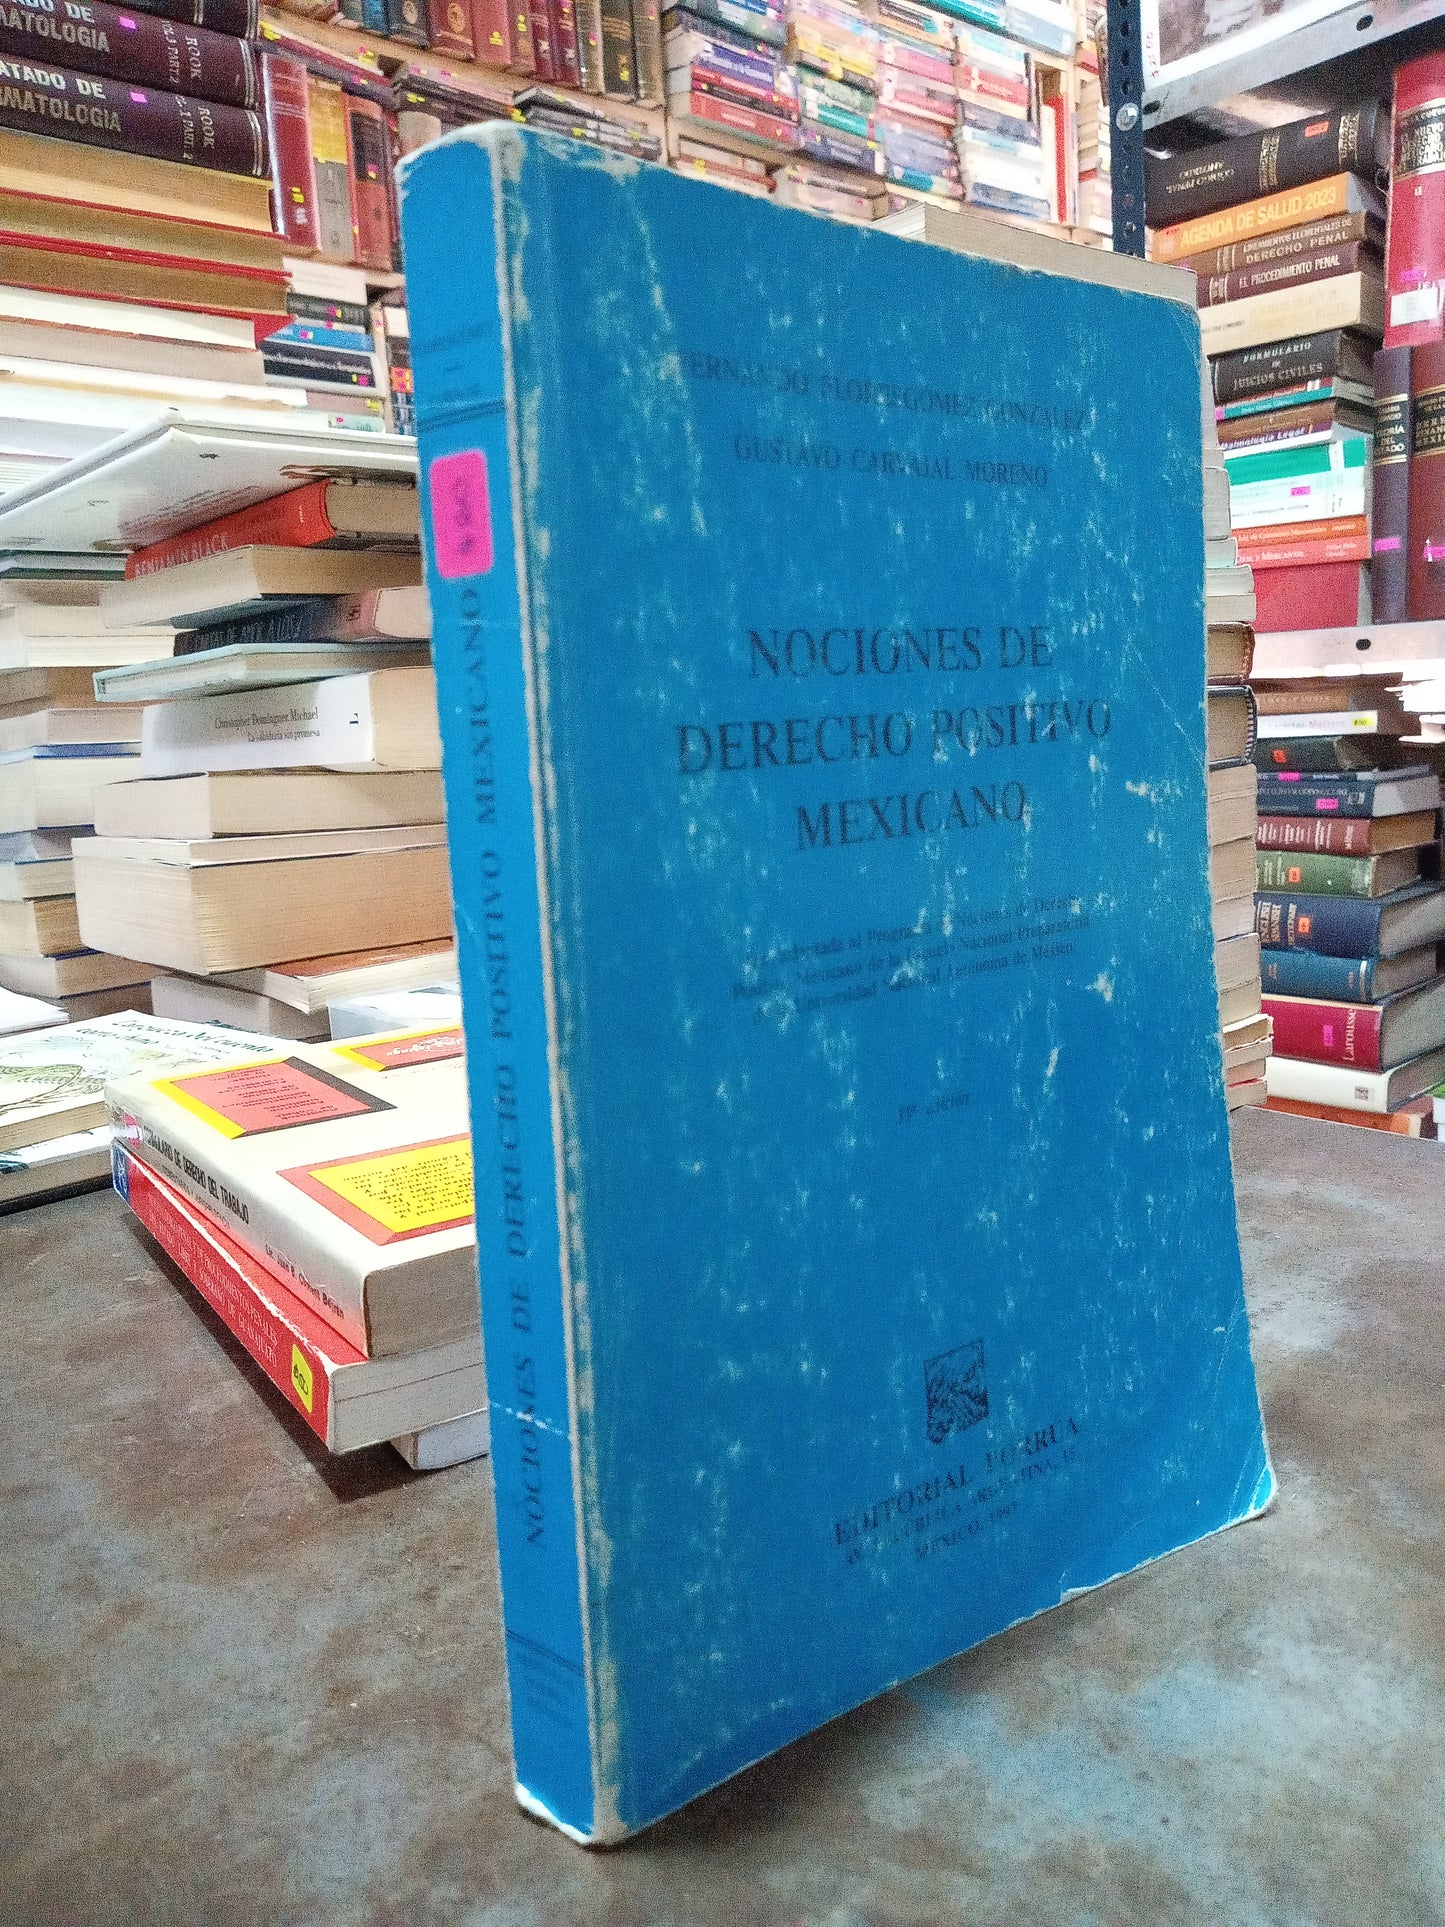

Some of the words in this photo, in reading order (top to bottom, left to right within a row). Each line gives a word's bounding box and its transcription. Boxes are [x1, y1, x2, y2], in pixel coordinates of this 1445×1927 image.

[64, 2, 95, 23] DE
[185, 35, 202, 80] ROOK
[75, 78, 107, 99] DE
[197, 106, 215, 150] ROOK
[1179, 217, 1234, 248] AGENDA
[1235, 210, 1256, 232] DE
[1257, 195, 1303, 225] SALUD
[1304, 186, 1338, 213] 2023
[1238, 277, 1250, 289] EL
[1250, 260, 1313, 286] PROCEDIMIENTO
[1314, 254, 1341, 271] PENAL
[1245, 241, 1303, 264] DERECHO
[1309, 230, 1350, 249] PENAL
[1232, 372, 1276, 391] JUICIOS
[1277, 362, 1323, 381] CIVILES
[1242, 341, 1312, 364] FORMULARIO
[733, 432, 842, 472] GUSTAVO
[850, 447, 956, 482] CARVAJAL
[965, 458, 1049, 487] MORENO
[191, 532, 229, 562] BLACK
[746, 626, 984, 680] NOCIONES
[998, 626, 1055, 669] DE
[289, 706, 319, 723] Michael
[459, 588, 498, 827] MEXICANO
[294, 728, 320, 742] promesa
[675, 710, 914, 776] DERECHO
[930, 698, 1114, 756] POSITIVO
[795, 780, 1028, 853] MEXICANO
[478, 850, 515, 1041] POSITIVO
[1342, 1007, 1358, 1062] Larousse
[494, 1063, 529, 1258] DERECHO
[207, 1175, 220, 1200] DEL
[219, 1184, 250, 1225] TRABAJO
[509, 1277, 535, 1335] DE
[511, 1357, 548, 1549] NOCIONES
[834, 1463, 973, 1546] EDITORIAL
